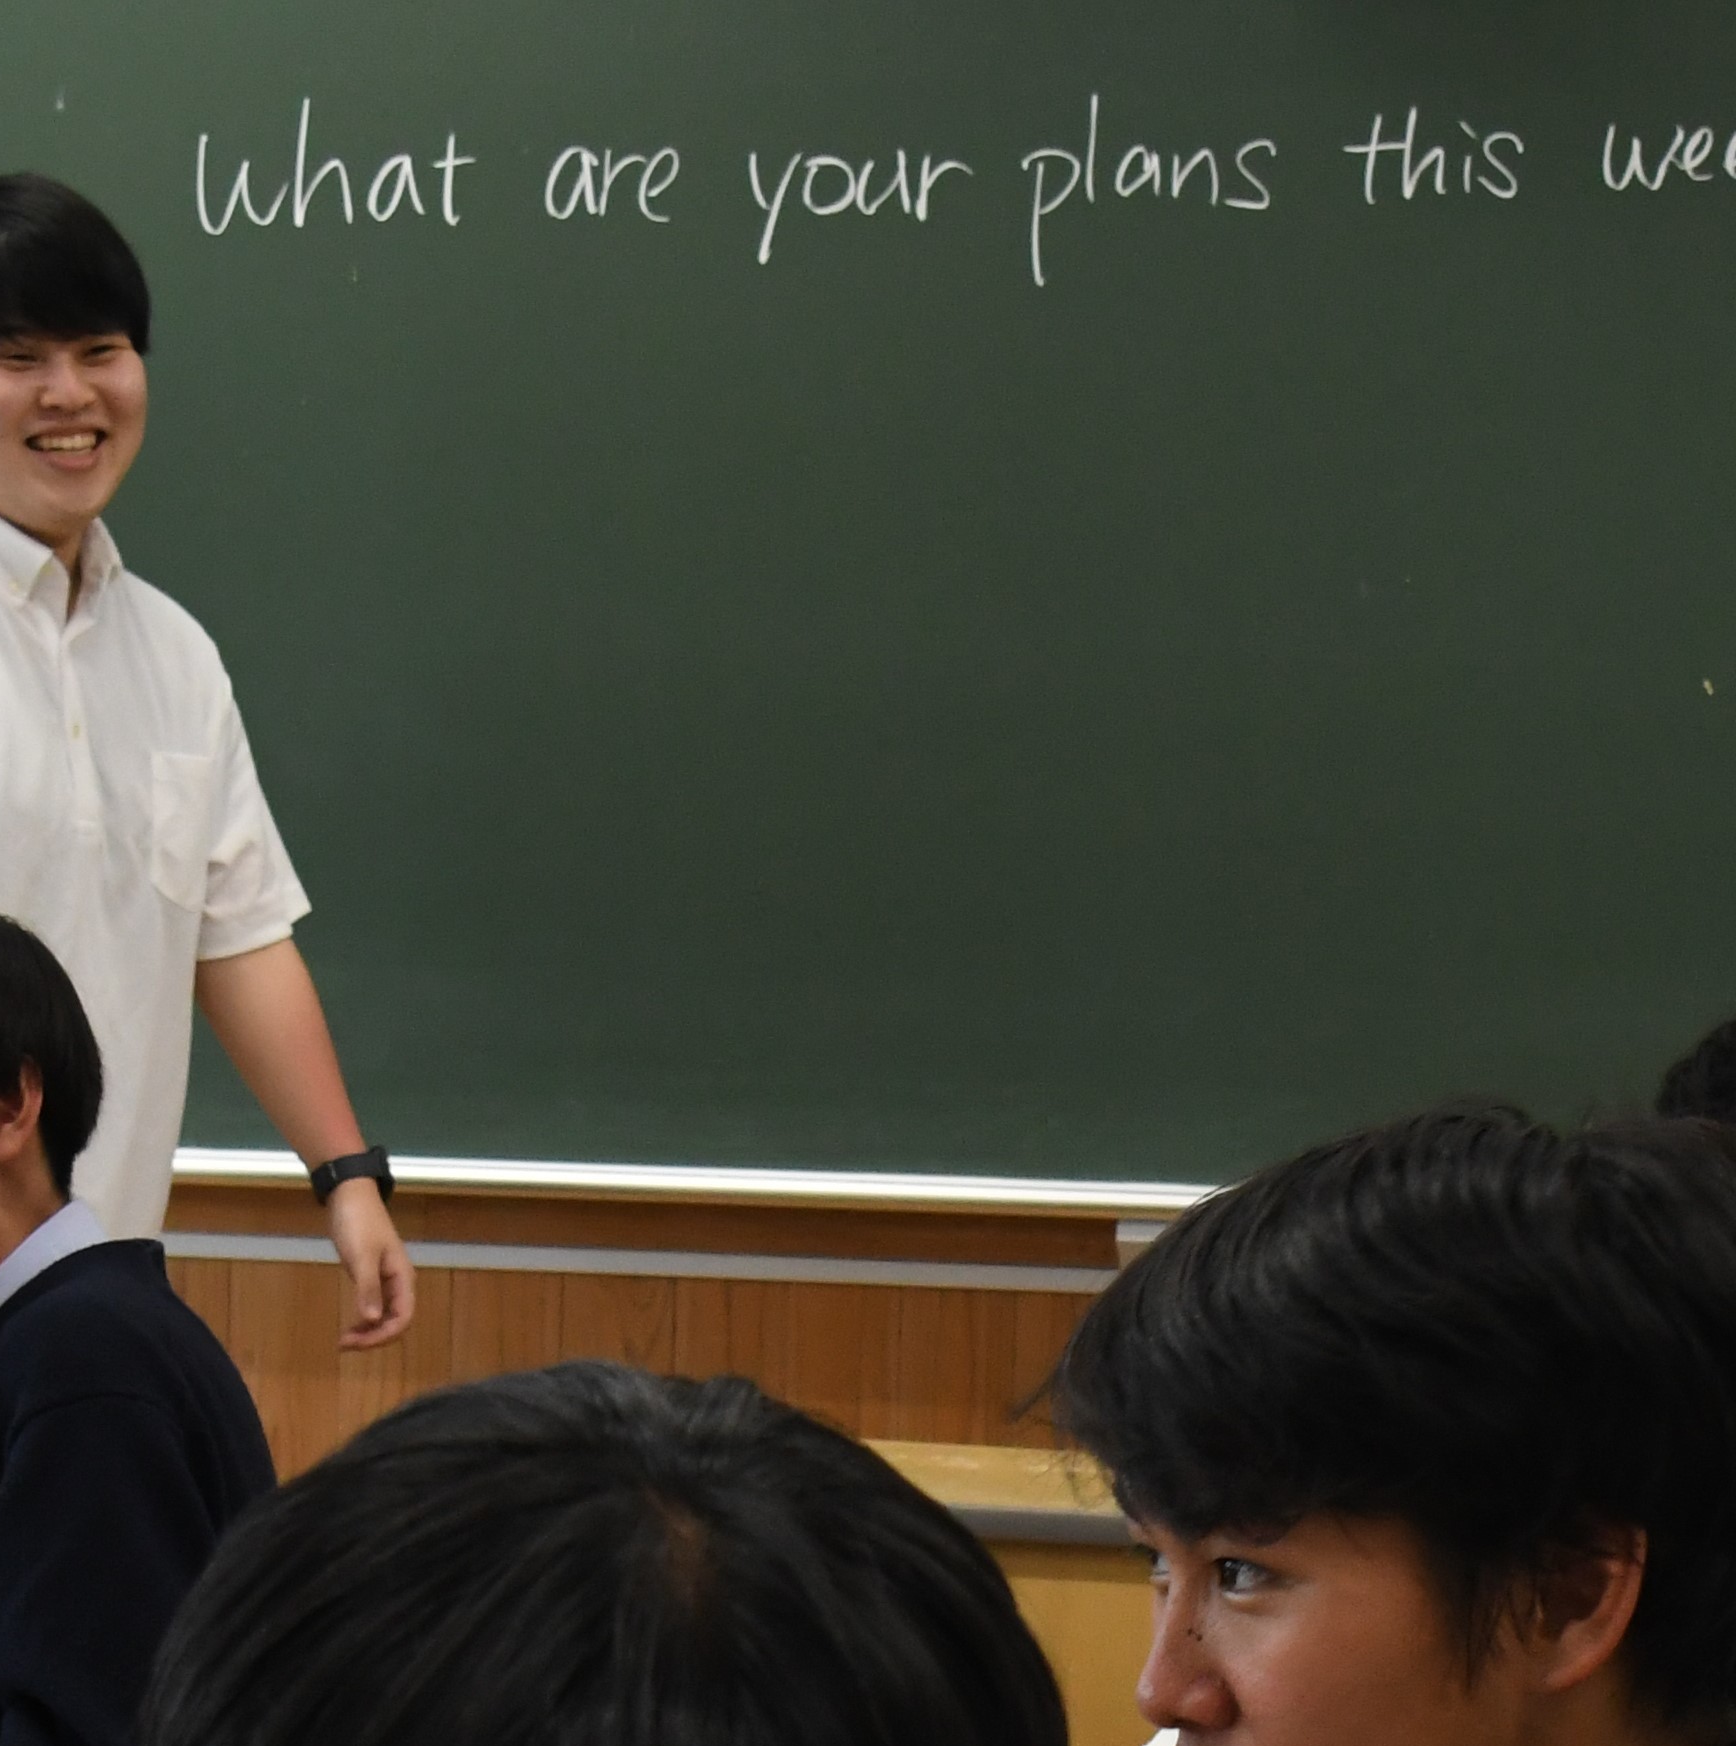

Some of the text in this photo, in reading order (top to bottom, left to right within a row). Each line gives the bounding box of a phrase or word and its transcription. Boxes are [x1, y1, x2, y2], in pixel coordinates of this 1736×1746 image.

[195, 96, 476, 236] What
[544, 145, 681, 223] are
[748, 148, 974, 266] your
[1020, 93, 1277, 288] plans
[1342, 105, 1525, 205] this
